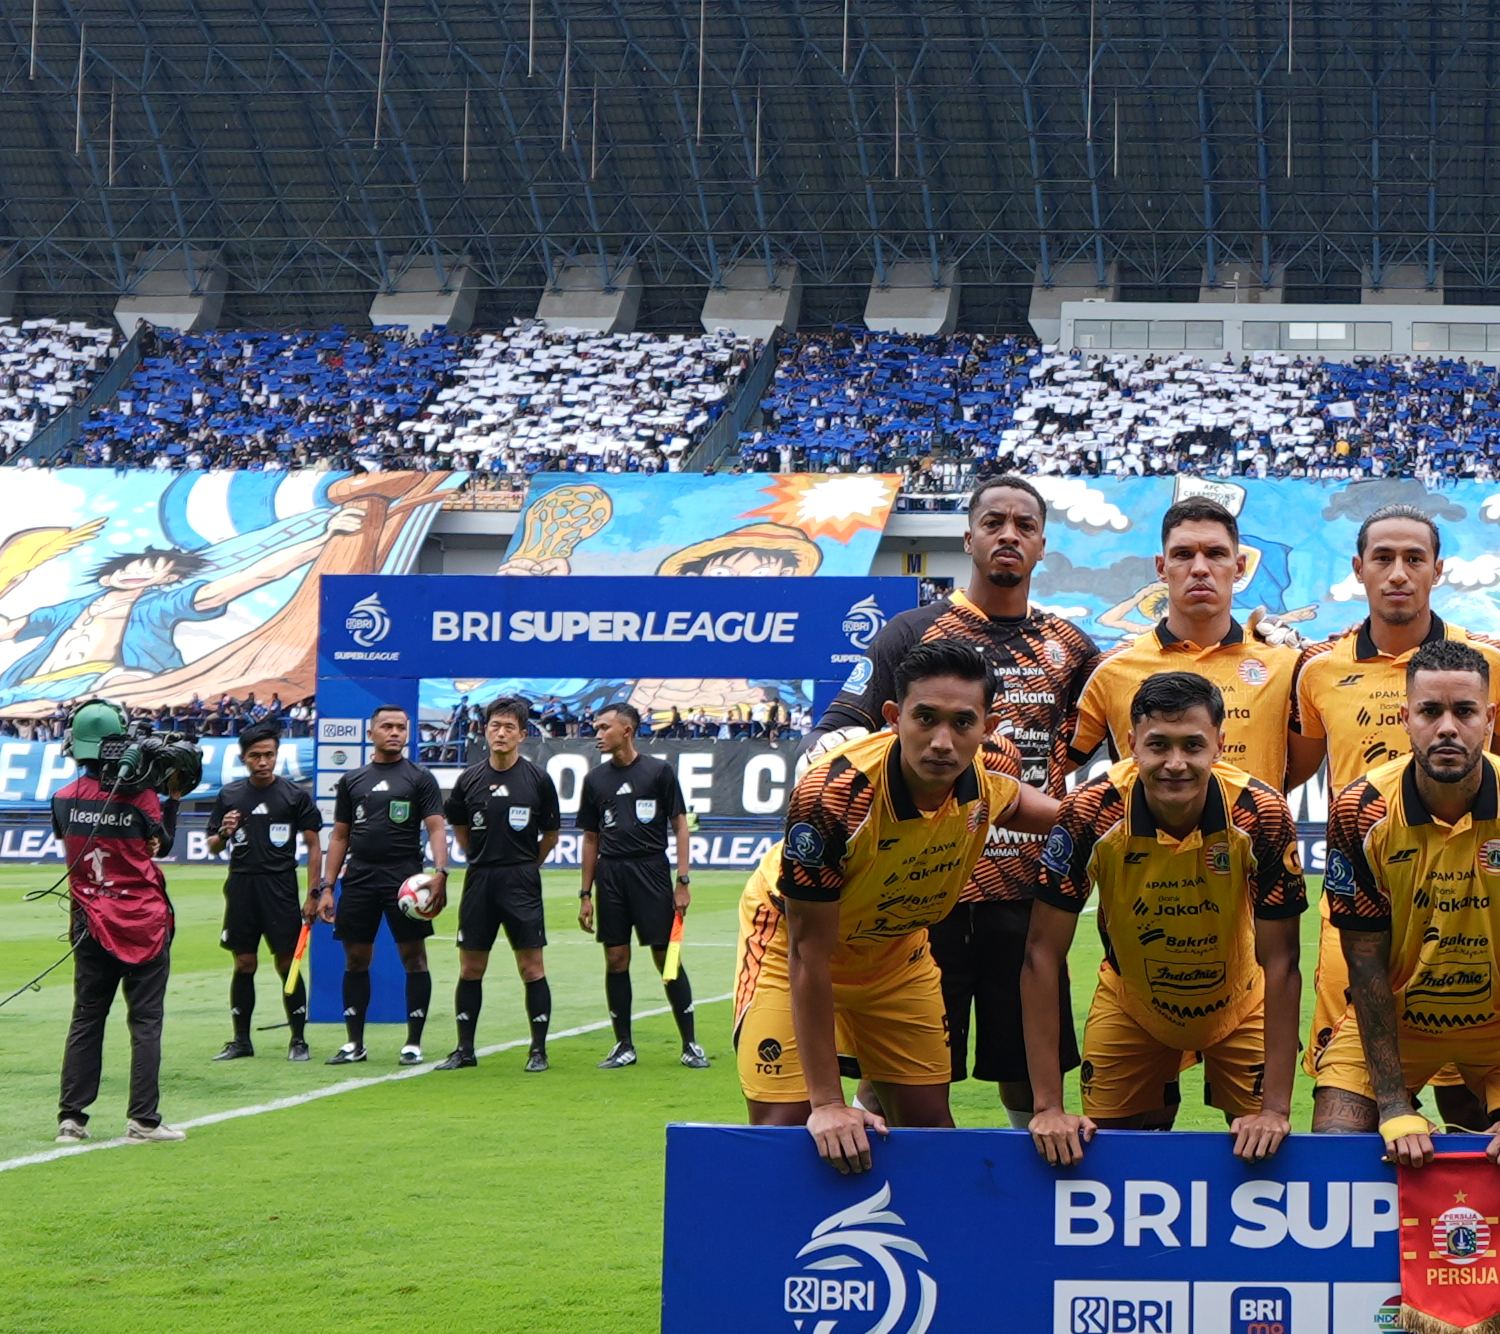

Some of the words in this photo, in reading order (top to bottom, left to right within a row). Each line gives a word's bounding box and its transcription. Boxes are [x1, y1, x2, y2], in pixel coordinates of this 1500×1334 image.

[1184, 491, 1236, 500] CHAMPIONS
[1203, 484, 1219, 492] AFC
[907, 554, 922, 574] M
[433, 611, 501, 642] BRI
[1000, 667, 1021, 676] PAM
[1022, 668, 1045, 676] JAYA
[1002, 690, 1055, 704] Jakarta
[1376, 691, 1399, 699] PAM
[337, 721, 356, 736] BRI
[1014, 728, 1049, 742] Bakrie
[984, 848, 1019, 857] AMMAN
[1431, 871, 1454, 881] PAM
[1152, 880, 1178, 890] PAM
[1154, 899, 1220, 917] Jakarta
[1435, 894, 1490, 913] Jakarta
[1166, 933, 1218, 948] Bakrie
[1438, 932, 1489, 948] Bakrie
[755, 1063, 782, 1075] TCT
[1055, 1180, 1208, 1247] BRI
[1426, 1267, 1499, 1286] PERSIJA
[821, 1281, 874, 1311] BRI
[1113, 1300, 1172, 1334] BRI
[1240, 1299, 1282, 1322] BRI
